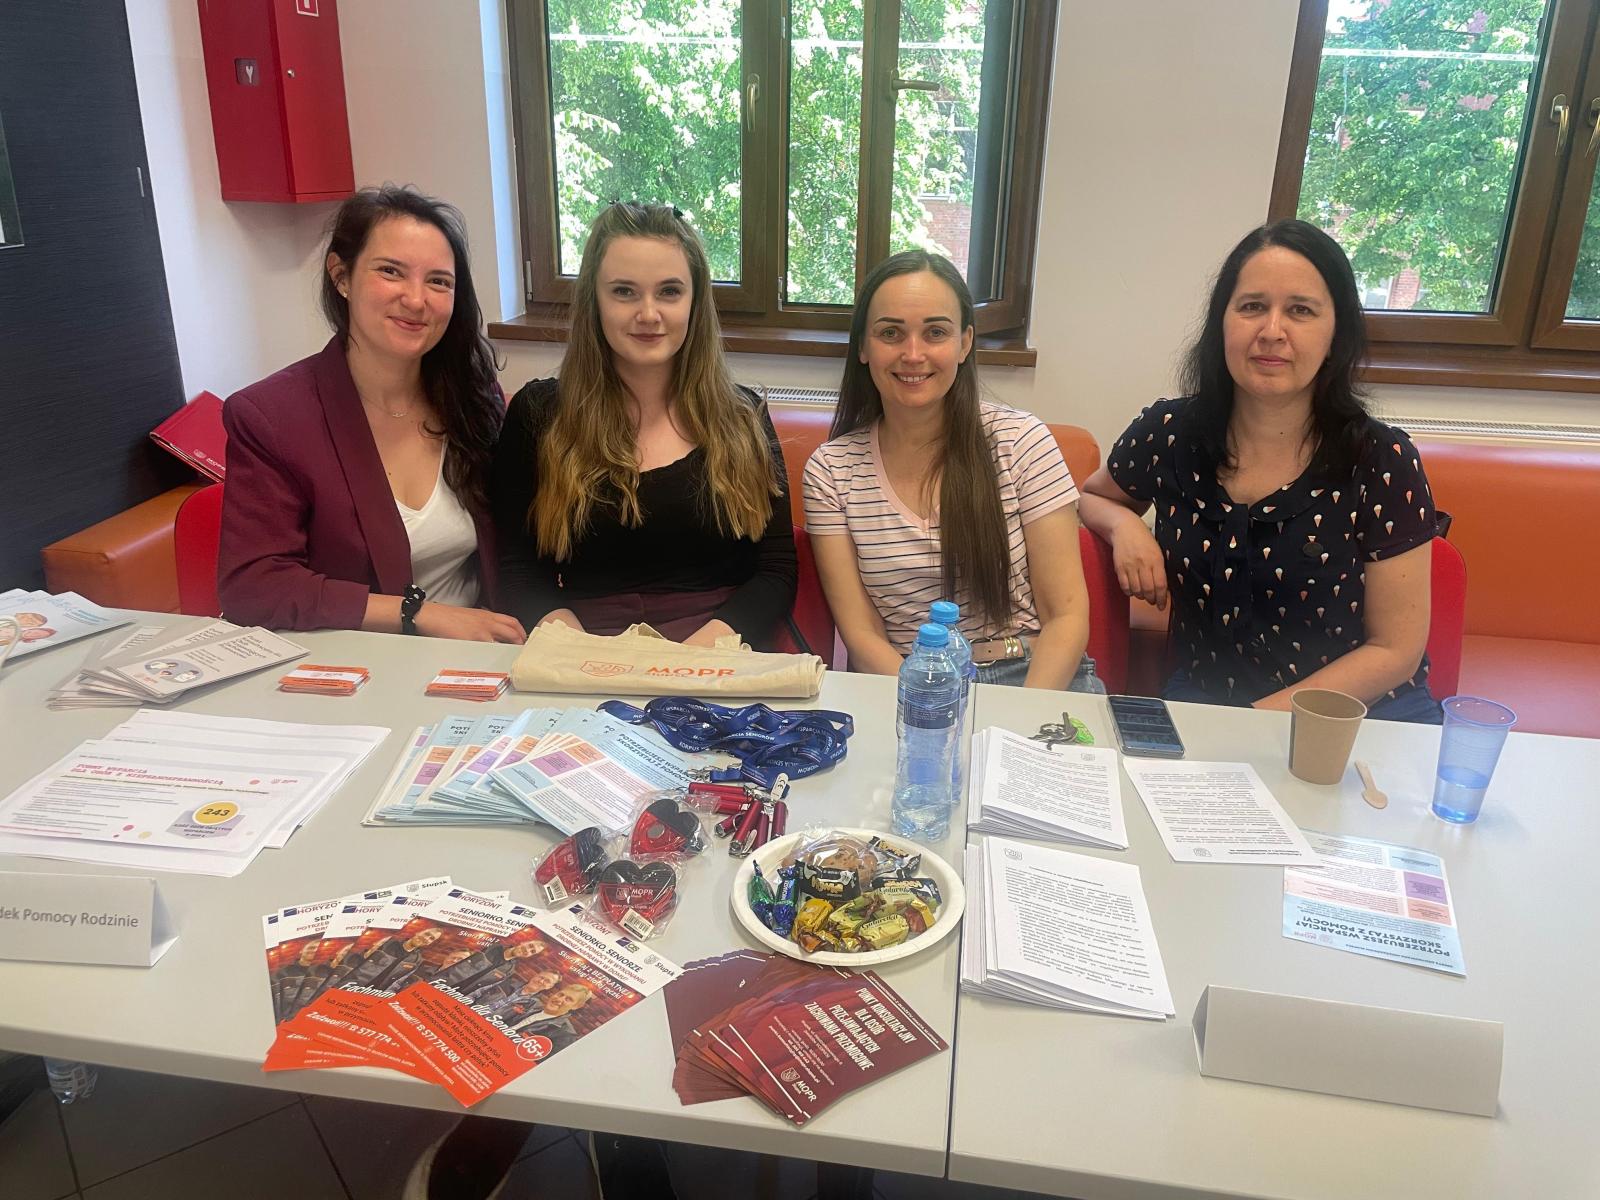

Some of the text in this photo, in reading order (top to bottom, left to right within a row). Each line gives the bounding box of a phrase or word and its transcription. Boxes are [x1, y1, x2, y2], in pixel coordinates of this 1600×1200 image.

[647, 667, 735, 677] MOPR
[617, 738, 655, 764] SKORZYSTAJ
[619, 733, 665, 763] POTRZEBUJESZ
[202, 808, 230, 817] 243
[457, 895, 502, 909] HORYZONT
[631, 888, 653, 896] MOPR
[23, 909, 77, 926] Pomocy
[81, 913, 139, 928] Rodzinie
[439, 909, 485, 924] POTRZEBUJESZ
[485, 920, 511, 930] POMOCY
[459, 907, 503, 923] SENIORKO,
[448, 917, 509, 935] DROBNEJ NAPRAWY
[570, 925, 643, 973] SENIORKO, SENIORZE
[1362, 935, 1450, 957] POTRZEBUJESZ
[1368, 930, 1441, 948] SKORZYSTAJ
[552, 923, 587, 948] POTRZEBUJESZ
[586, 944, 607, 961] POMOCY
[614, 962, 647, 985] WYKONANIU
[556, 934, 578, 951] DROBNEJ
[578, 947, 603, 966] NAPRAWY
[655, 962, 675, 977] Słupsk
[338, 982, 396, 998] Fachman
[428, 978, 525, 1043] Fachman dla Seniora
[856, 987, 918, 1044] PUNKT KONSULTACYJNY
[829, 1004, 881, 1054] PRZEJAWIAJĄCYCH
[855, 1008, 886, 1035] DLA OSÓB
[358, 1027, 375, 1037] 577
[374, 1033, 392, 1043] 774
[421, 1029, 438, 1041] 577
[433, 1039, 449, 1053] 774
[445, 1050, 460, 1062] 500
[804, 1001, 842, 1036] ZACHOWANIA
[832, 1032, 875, 1071] PRZEMOCOWE
[523, 1039, 545, 1058] 65+
[796, 1080, 817, 1102] MOPR
